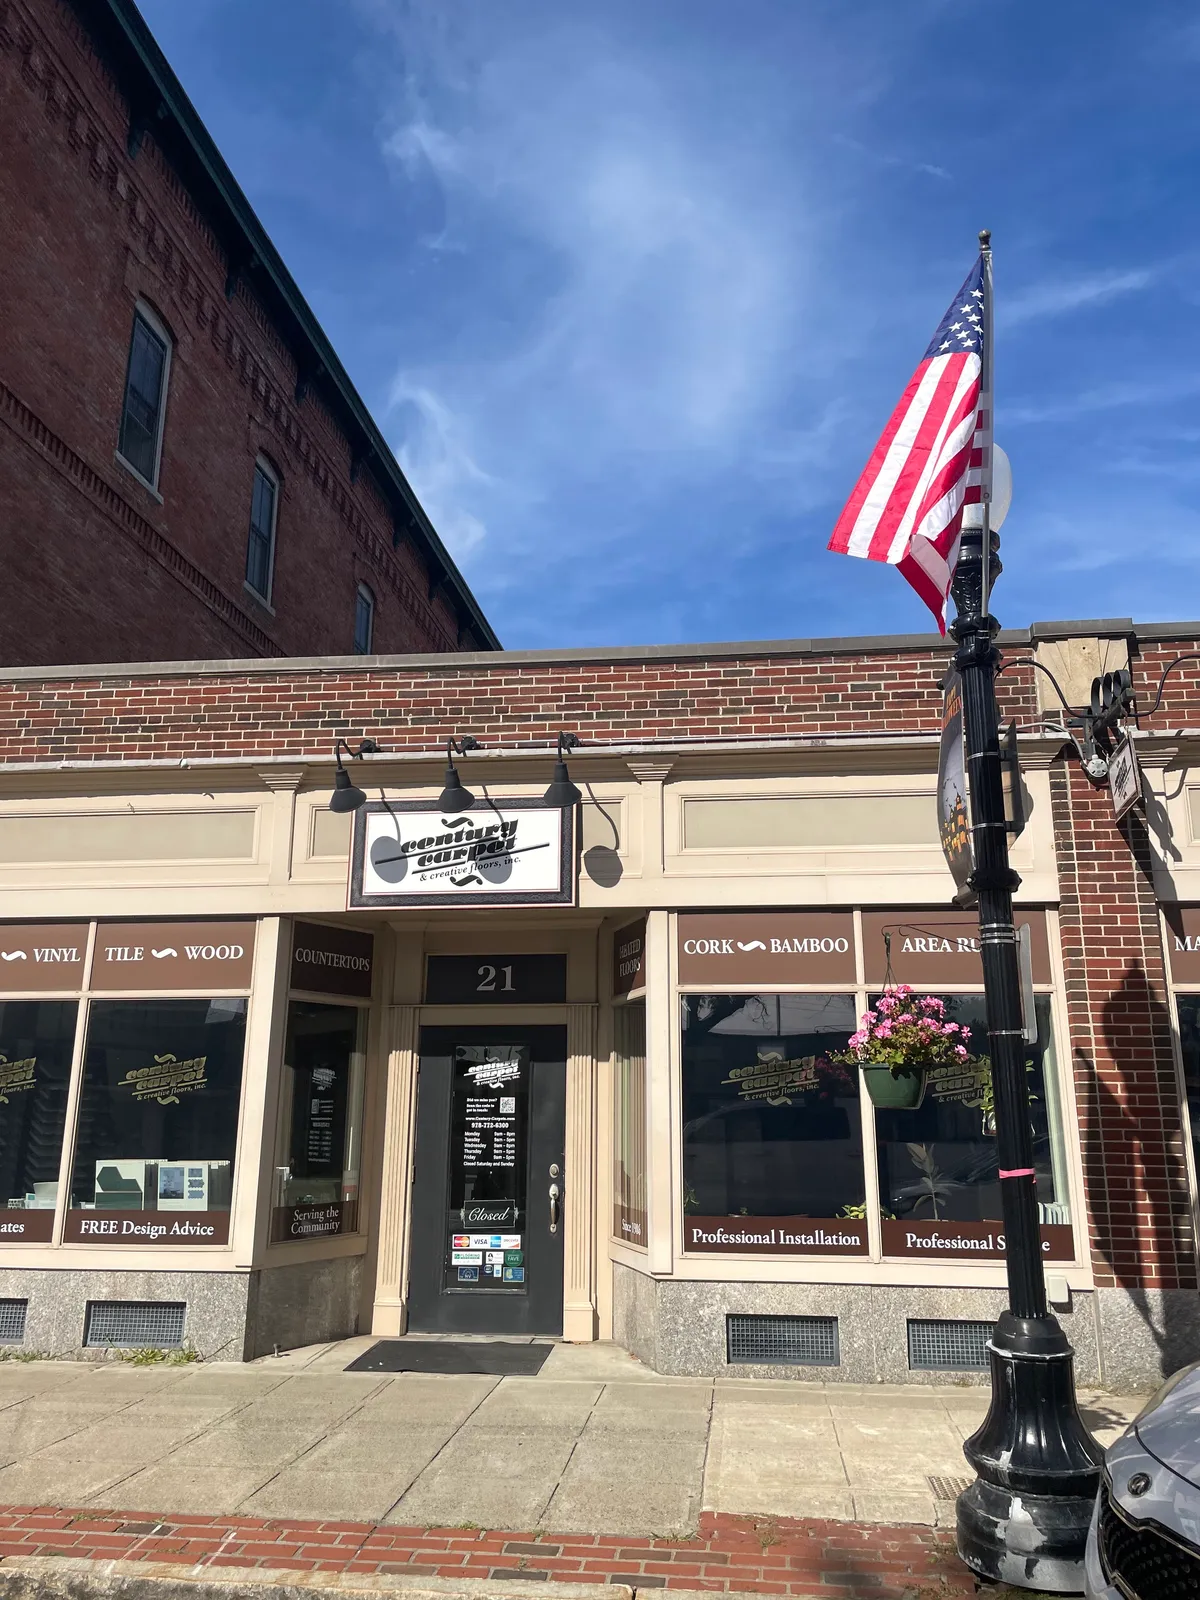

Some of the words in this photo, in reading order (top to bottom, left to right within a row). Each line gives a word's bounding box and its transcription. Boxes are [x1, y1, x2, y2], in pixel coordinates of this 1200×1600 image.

[400, 819, 519, 853] century
[417, 835, 519, 867] carpet
[419, 873, 428, 881] &
[429, 866, 468, 880] creative
[468, 858, 502, 874] floors,
[504, 856, 521, 866] inc.
[105, 946, 144, 961] TILE
[184, 945, 244, 960] WOOD
[684, 938, 735, 954] CORK
[770, 937, 849, 953] BAMBOO
[901, 937, 952, 952] AREA
[33, 948, 81, 962] VINYL
[294, 947, 370, 972] COUNTERTOPS
[620, 957, 641, 977] FLOORS
[476, 965, 516, 991] 21
[126, 1056, 207, 1080] century
[729, 1055, 815, 1079] century
[136, 1068, 205, 1090] carpet
[741, 1066, 815, 1090] carpet
[144, 1089, 170, 1100] creative
[194, 1083, 206, 1091] inc.
[751, 1089, 779, 1100] creative
[806, 1082, 820, 1090] inc.
[946, 1091, 976, 1101] creative
[294, 1209, 325, 1222] Serving
[326, 1206, 339, 1218] the
[468, 1207, 510, 1221] Closed
[80, 1220, 118, 1234] FREE
[121, 1221, 167, 1239] Design
[169, 1221, 214, 1235] Advice
[291, 1219, 340, 1234] Community
[692, 1229, 775, 1245] Professional
[779, 1230, 861, 1246] Installation
[905, 1233, 994, 1250] Professional
